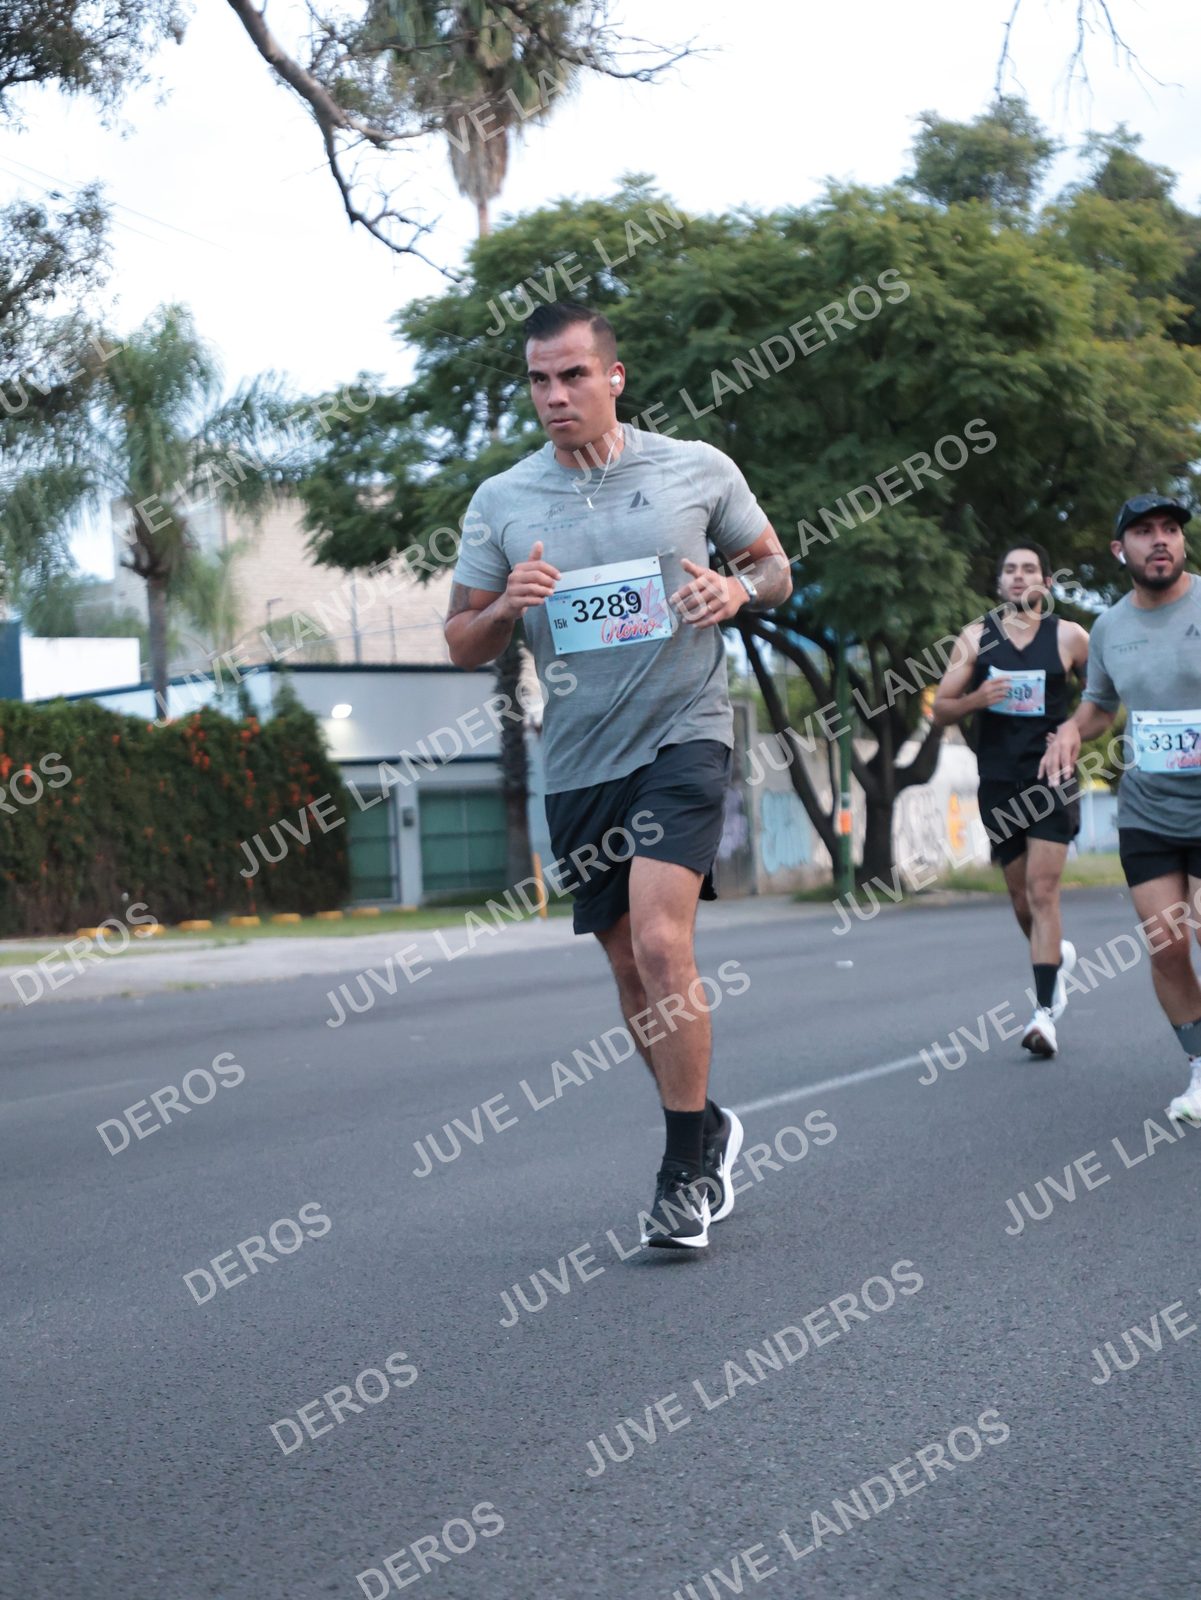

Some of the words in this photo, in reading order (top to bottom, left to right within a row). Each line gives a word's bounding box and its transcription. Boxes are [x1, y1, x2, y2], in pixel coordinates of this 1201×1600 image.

[571, 590, 642, 623] 3289
[553, 618, 568, 630] 15k
[1149, 732, 1200, 751] 3317
